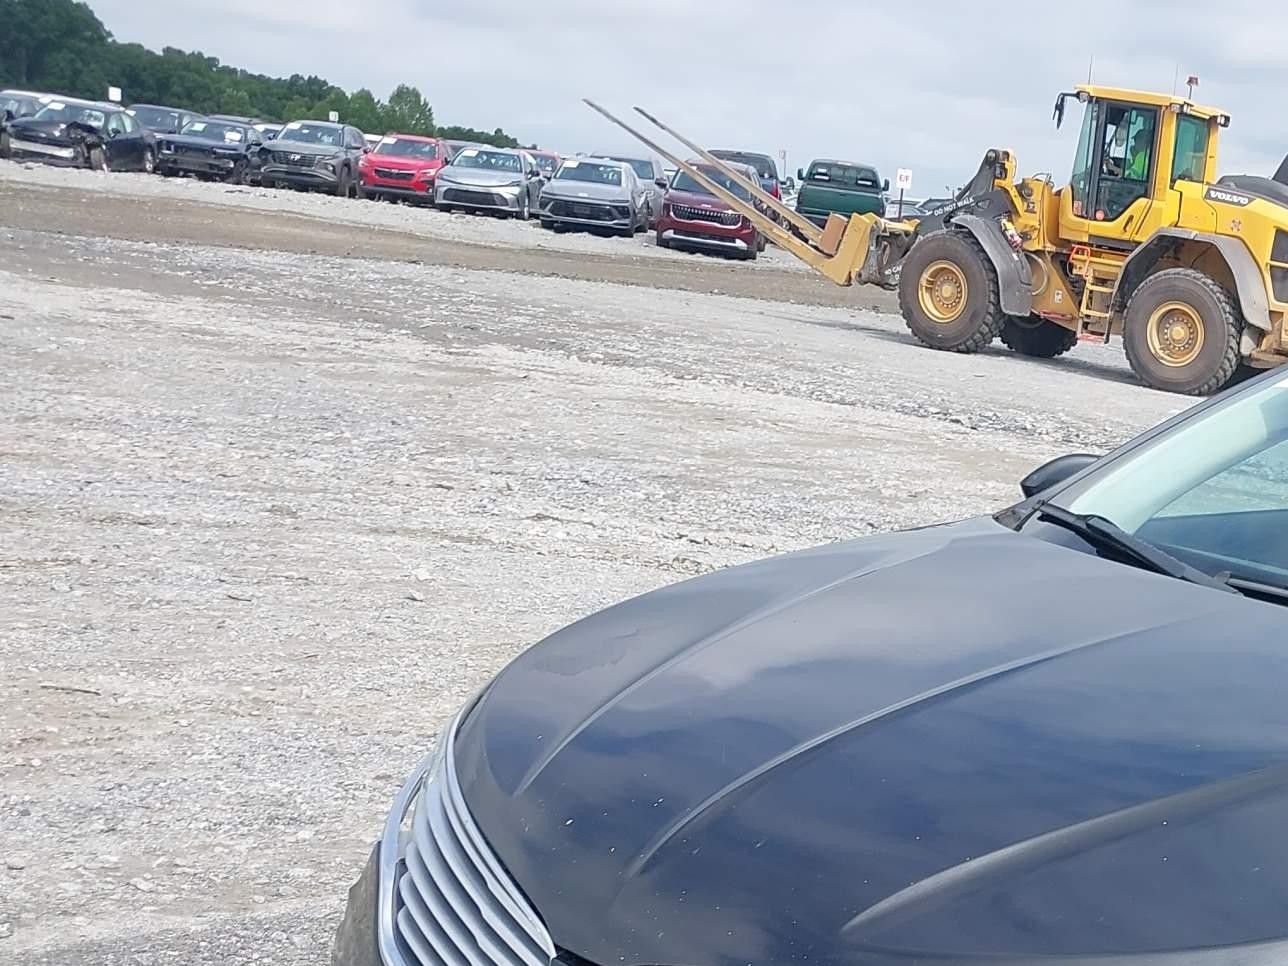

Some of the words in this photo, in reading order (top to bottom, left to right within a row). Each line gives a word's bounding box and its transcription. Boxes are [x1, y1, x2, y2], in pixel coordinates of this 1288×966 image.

[1209, 190, 1249, 205] VOLVO
[934, 207, 943, 216] DO
[944, 202, 956, 212] NOT
[957, 197, 974, 207] WALK
